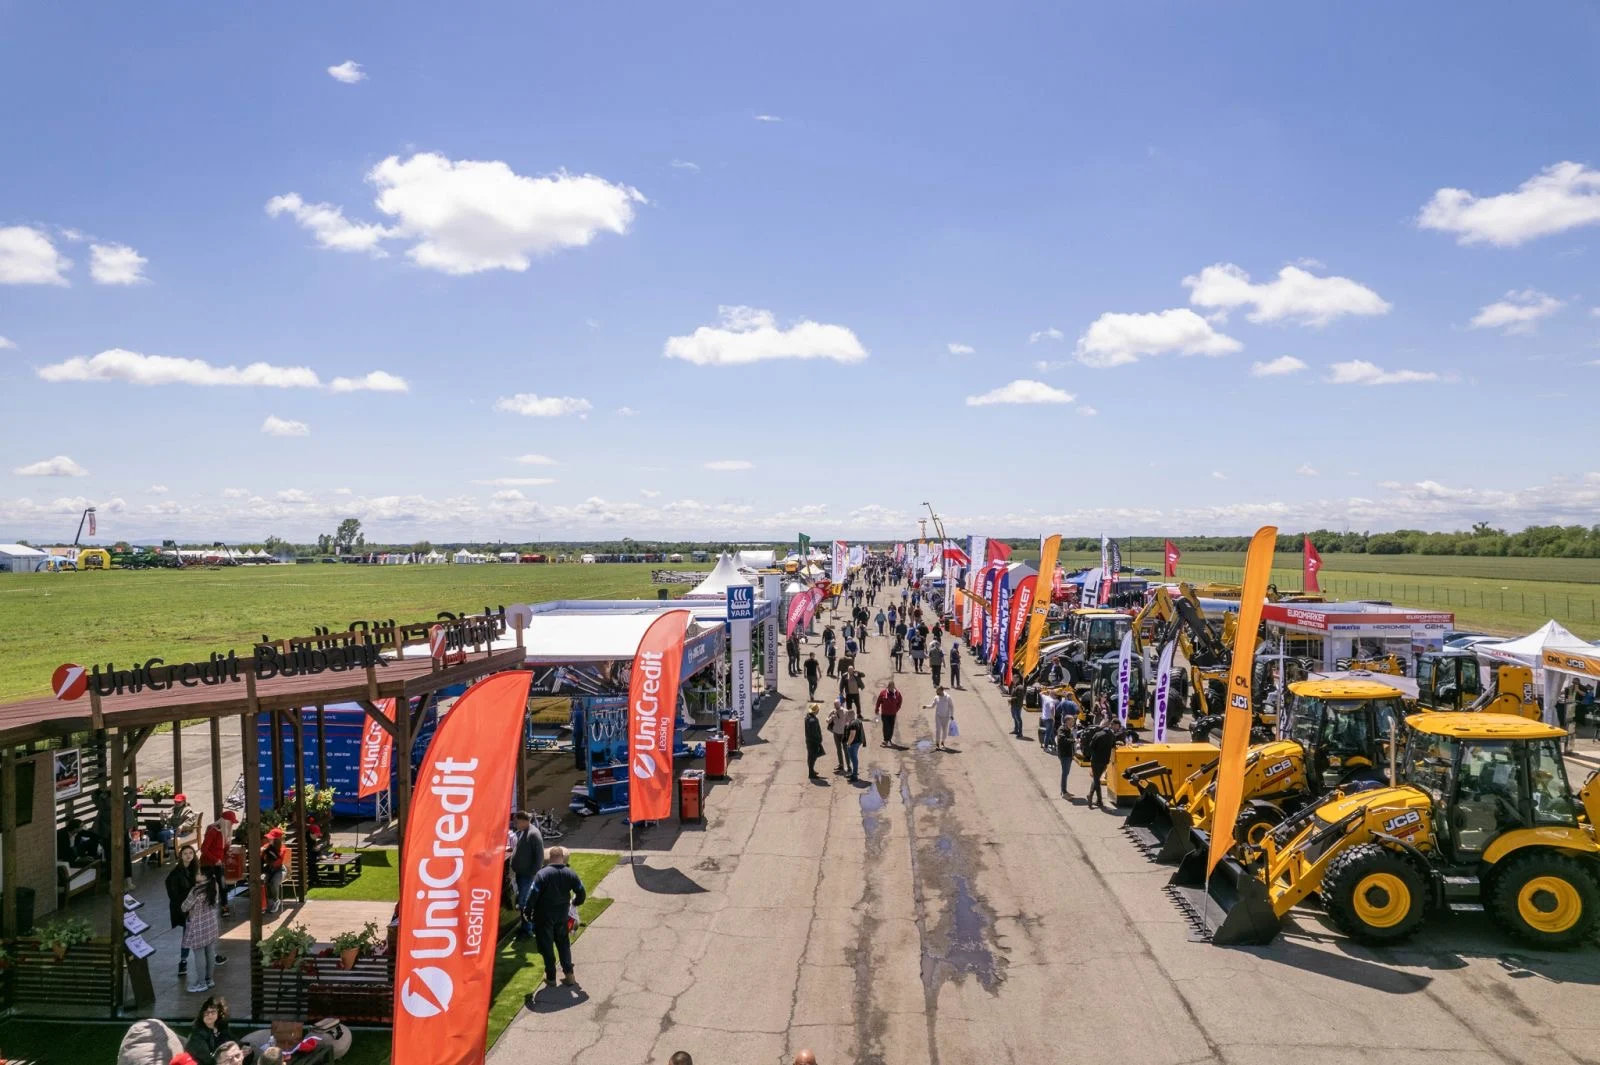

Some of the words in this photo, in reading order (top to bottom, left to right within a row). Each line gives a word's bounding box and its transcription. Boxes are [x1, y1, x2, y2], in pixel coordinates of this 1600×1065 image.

[1287, 609, 1326, 622] EUROMARKET
[92, 649, 241, 697] UniCredit
[253, 634, 389, 680] Bulbank
[767, 624, 775, 674] kvsagro.com
[1567, 658, 1585, 669] JCB
[634, 650, 664, 751] UniCredit
[739, 659, 747, 722] kvsagro.com
[659, 717, 671, 751] Leasing
[1265, 759, 1292, 777] JCB
[1385, 810, 1420, 832] JCB
[410, 756, 479, 959] UniCredit
[463, 888, 491, 956] Leasing
